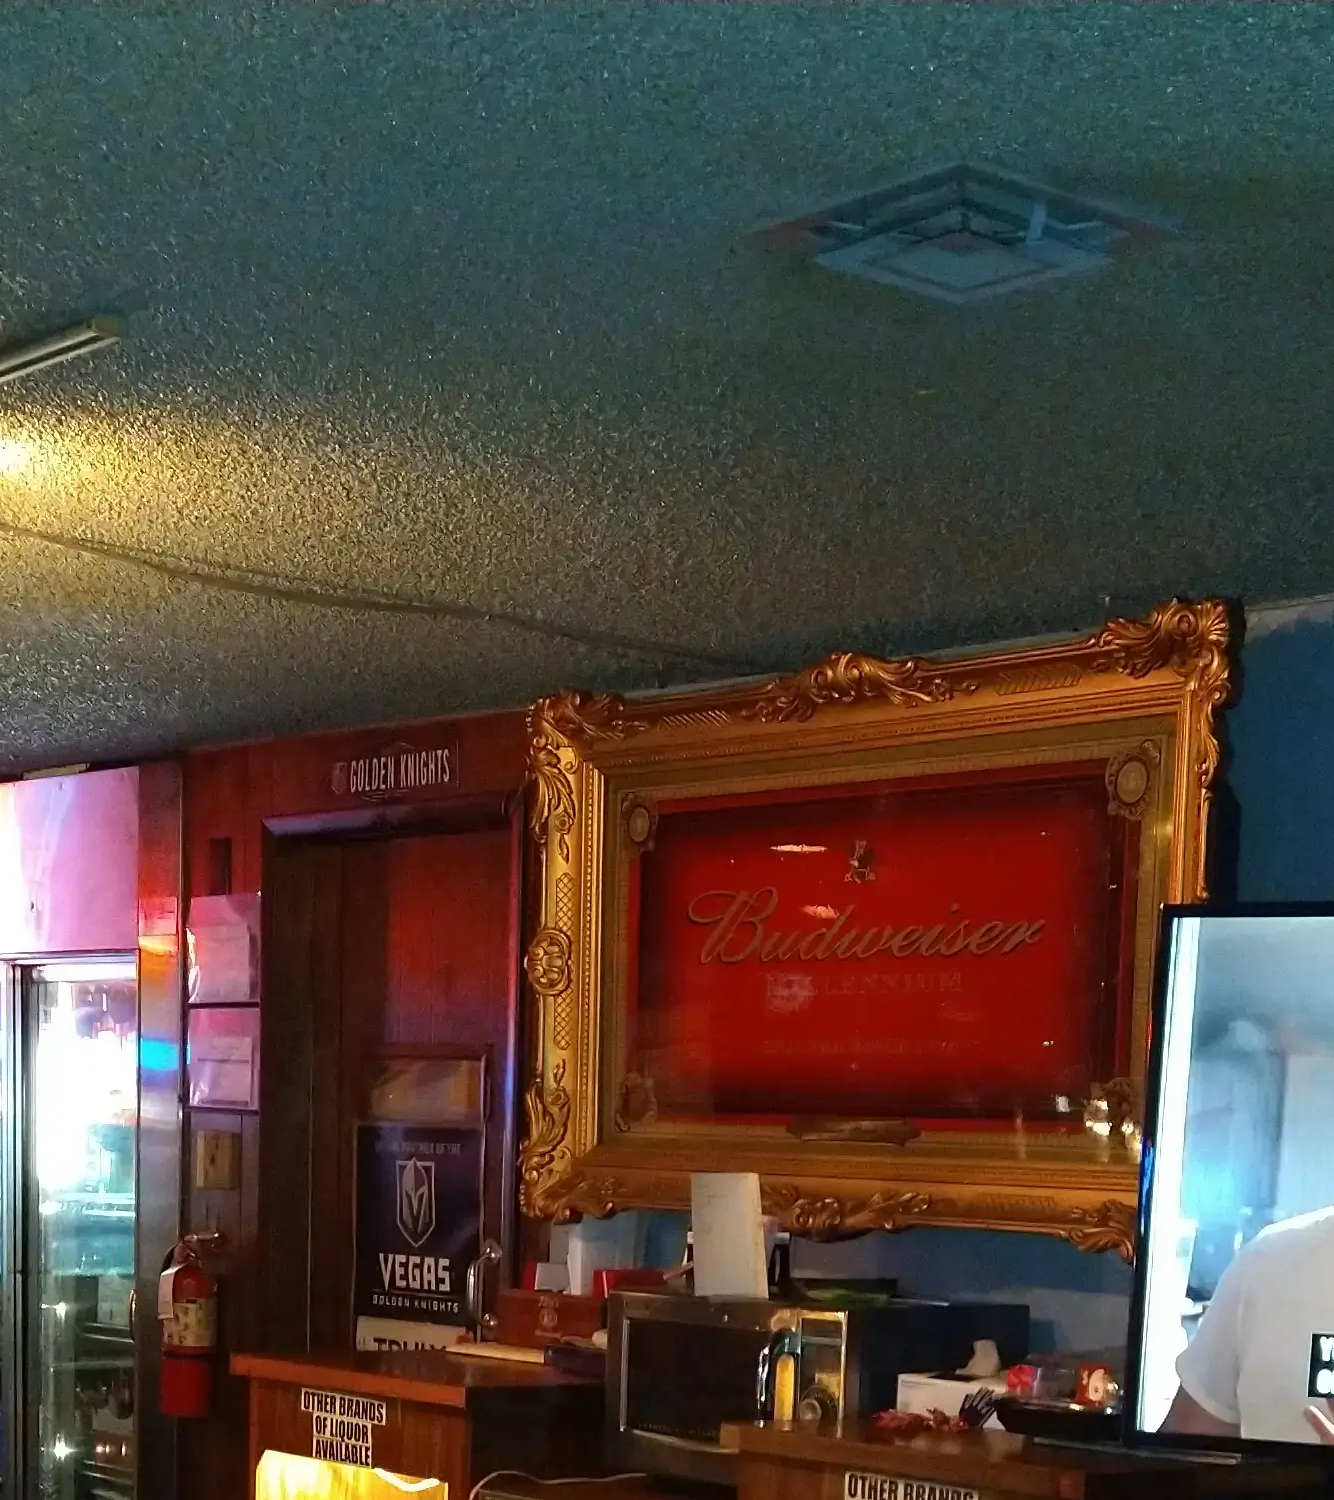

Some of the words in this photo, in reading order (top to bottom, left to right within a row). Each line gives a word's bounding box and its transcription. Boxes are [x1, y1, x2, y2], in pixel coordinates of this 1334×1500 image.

[349, 755, 395, 793] GOLDEN
[399, 748, 450, 789] KNIGHTS
[688, 886, 1045, 965] Budweiser
[378, 1252, 451, 1293] VEGAS
[372, 1294, 411, 1308] GOLDEN
[414, 1299, 460, 1314] KNIGHTS
[303, 1391, 337, 1415] OTHER
[338, 1396, 384, 1424] BRANDS
[314, 1415, 328, 1436] OF
[329, 1417, 369, 1444] LIQUOR
[314, 1439, 371, 1467] AVAILABLE
